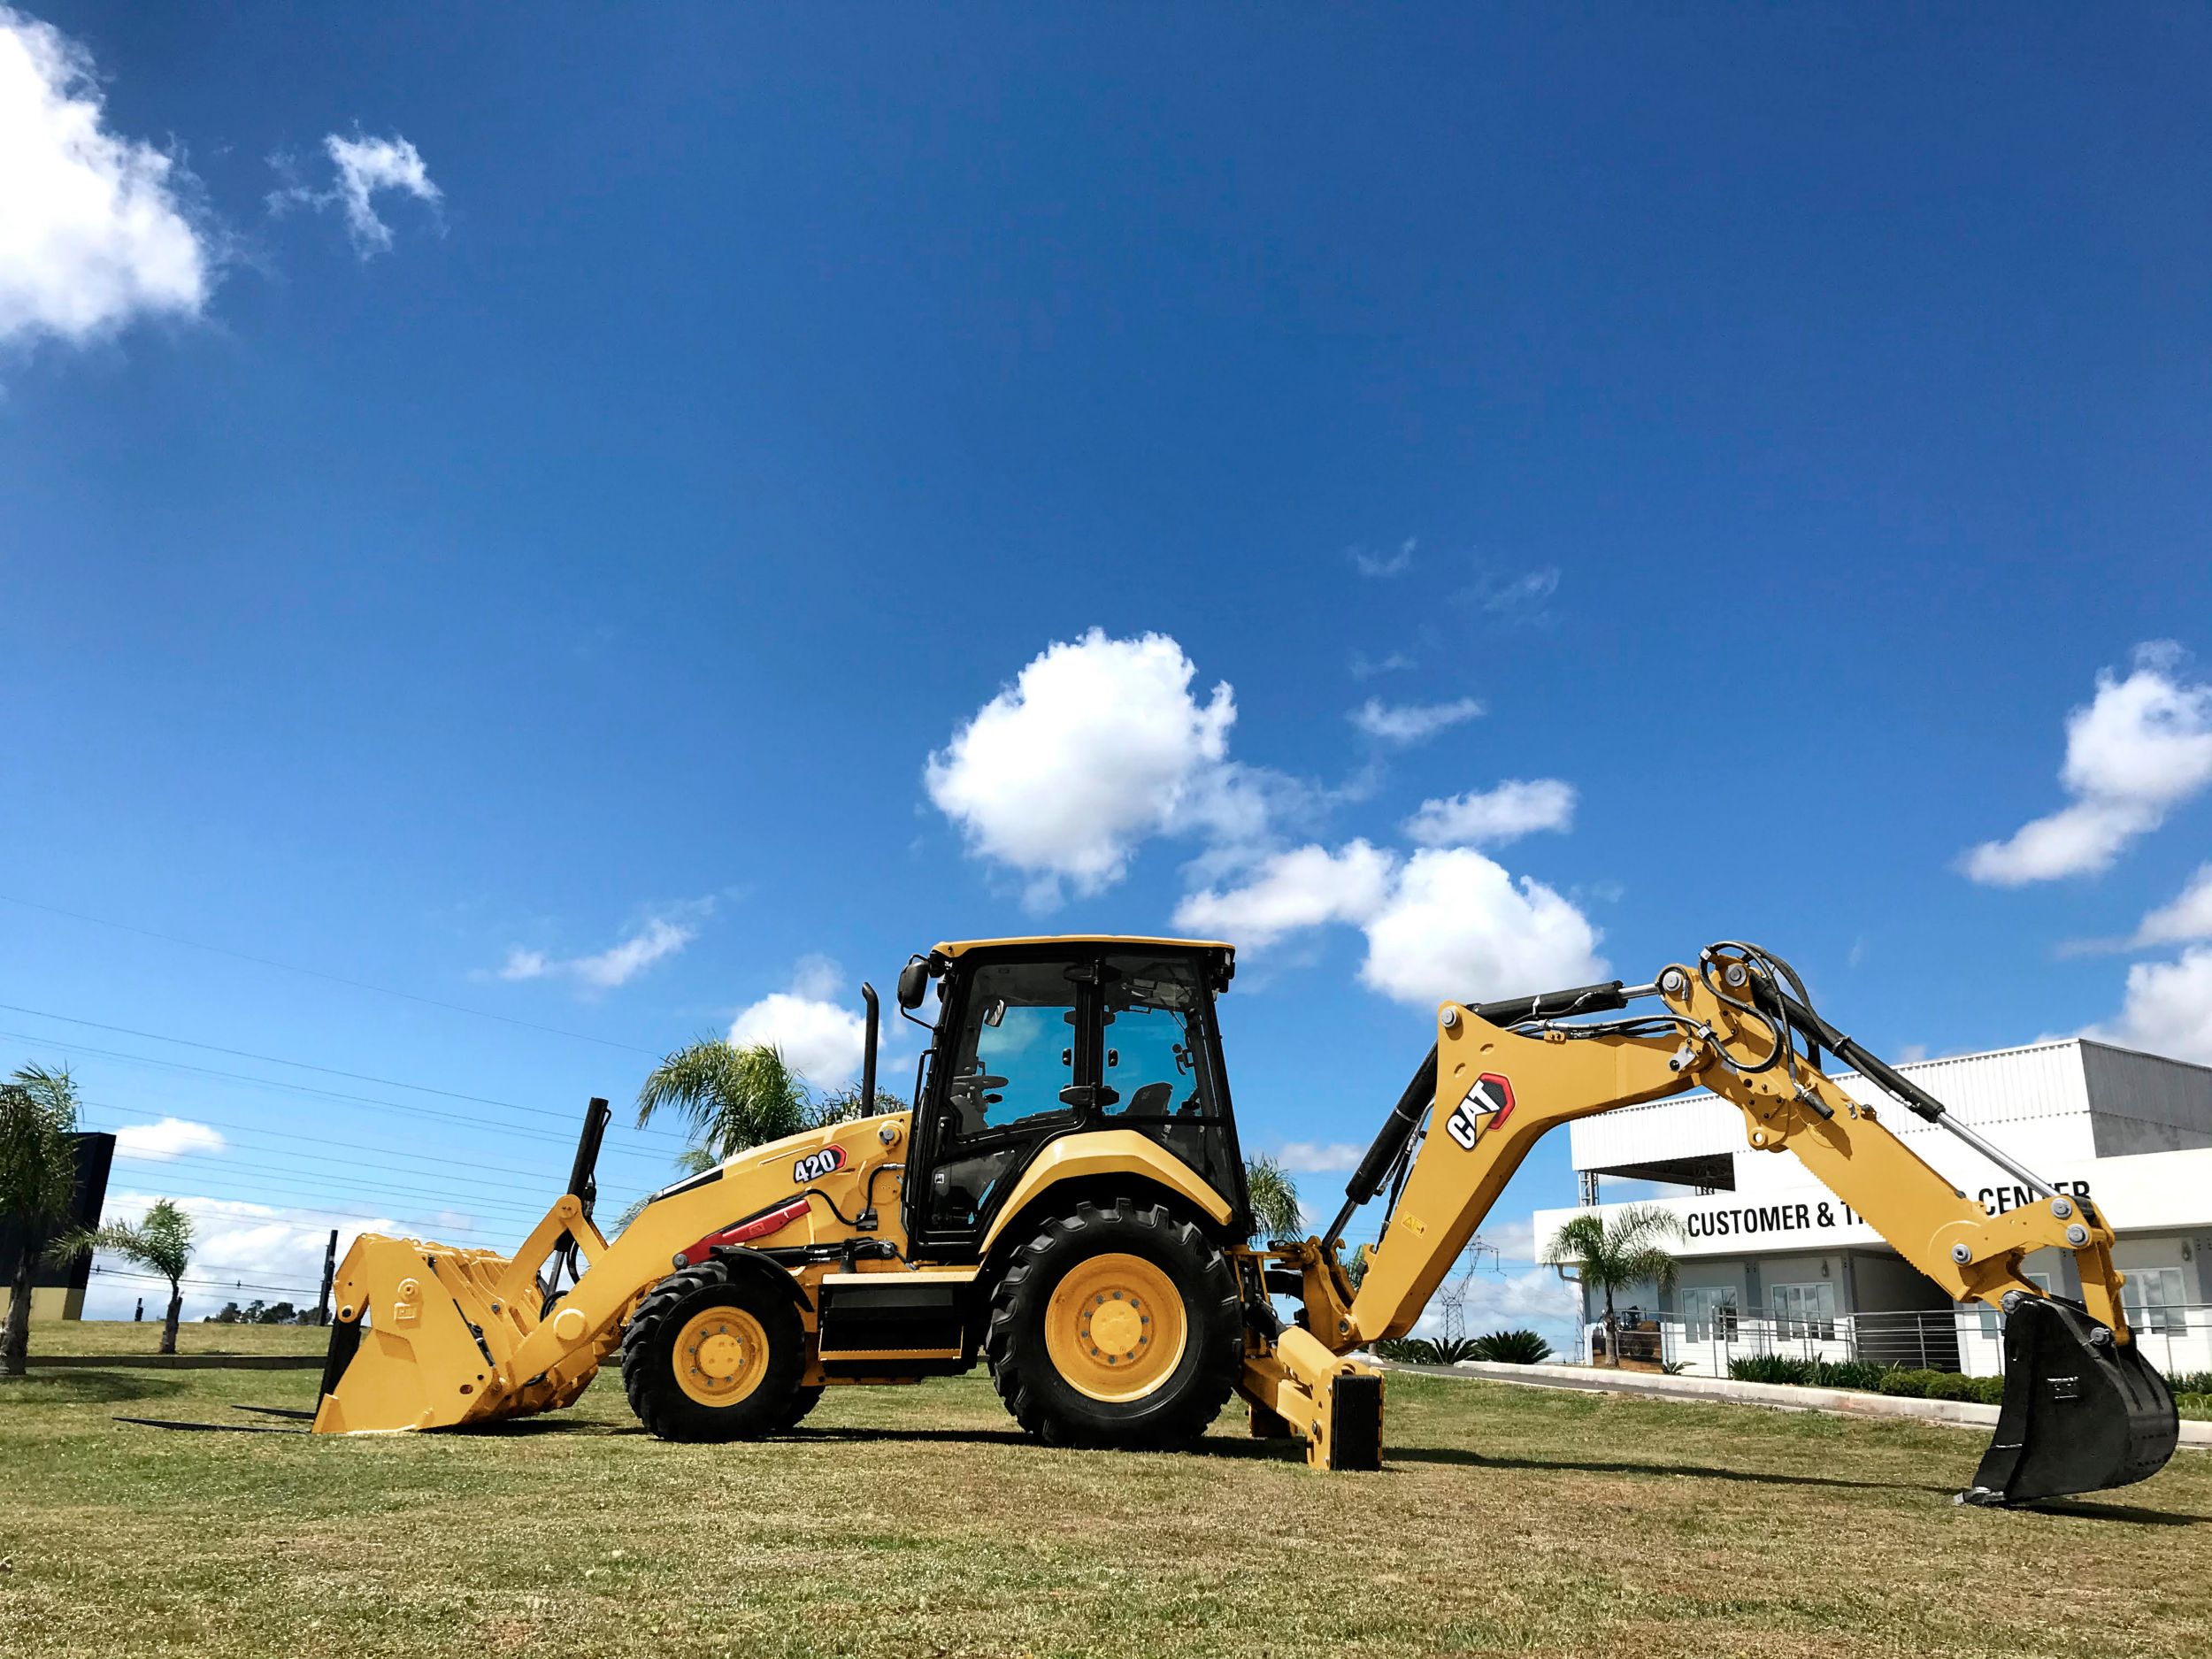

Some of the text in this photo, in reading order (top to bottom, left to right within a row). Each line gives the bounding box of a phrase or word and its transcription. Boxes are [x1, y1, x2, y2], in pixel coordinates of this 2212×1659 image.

[1447, 1079, 1501, 1149] CAT
[794, 1148, 836, 1183] 420
[1687, 1203, 1810, 1237] CUSTOMER
[1816, 1202, 1836, 1227] &
[1978, 1180, 2092, 1216] CENR
